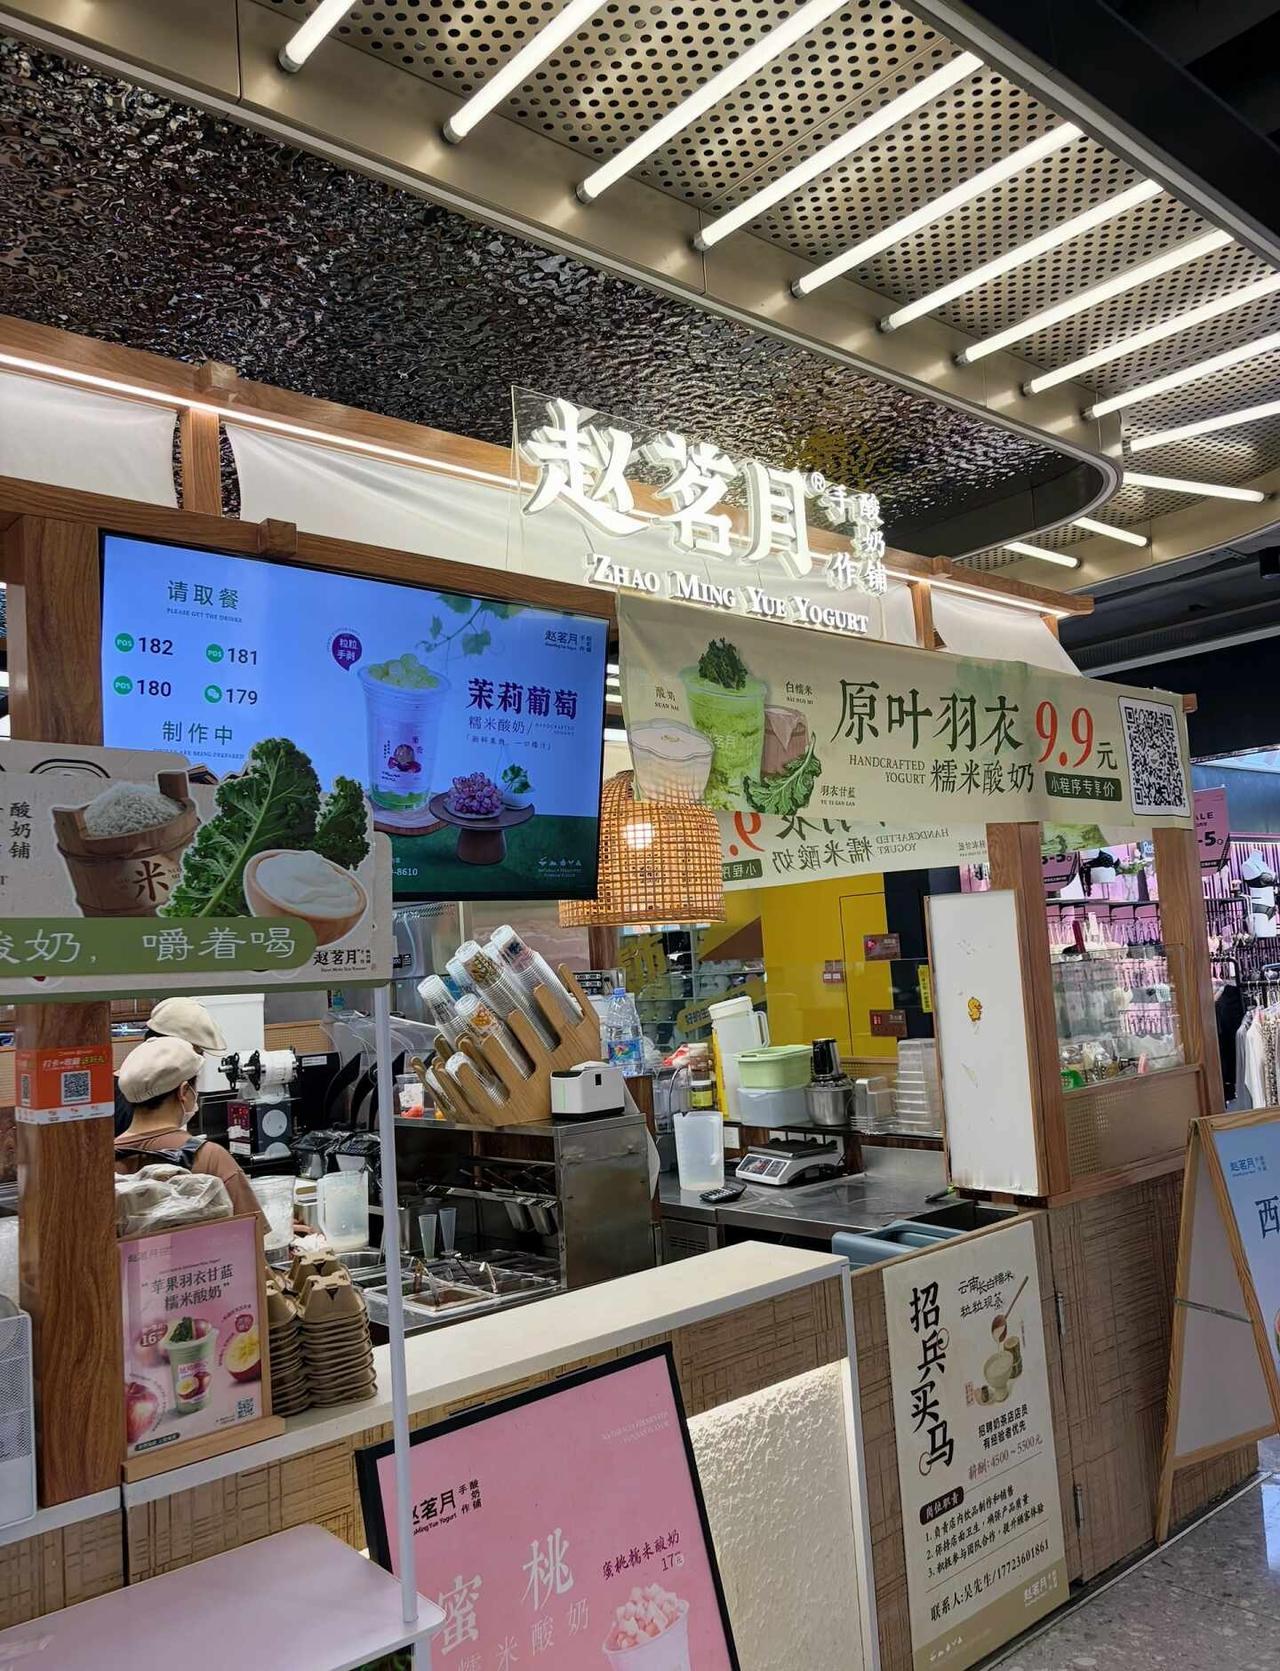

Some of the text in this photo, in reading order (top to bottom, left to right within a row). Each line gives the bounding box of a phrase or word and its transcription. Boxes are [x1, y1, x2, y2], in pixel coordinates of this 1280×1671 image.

[519, 398, 812, 578] 赵茗月
[167, 580, 239, 610] 请取餐
[590, 554, 869, 634] ZHAO MING YUE YOGURT
[116, 637, 174, 655] POS 182
[207, 648, 258, 665] POS 181
[115, 679, 171, 697] POS 180
[226, 688, 258, 705] 179
[466, 677, 578, 720] 茉莉葡萄
[655, 687, 676, 702] 酸奶
[786, 681, 813, 696] 白糯米
[831, 679, 1023, 755] 原叶羽衣
[162, 720, 233, 746] 制作中
[849, 754, 926, 771] HANDCRAFTED
[930, 759, 1035, 794] 糯米酸奶
[820, 785, 856, 798] 羽衣甘蓝
[884, 771, 926, 785] YOGURT
[1050, 775, 1116, 798] 小程序专享价
[8, 801, 33, 860] 酸奶铺
[132, 860, 170, 902] 米
[142, 926, 296, 962] 嚼着喝
[313, 949, 358, 966] 赵茗月
[1254, 1195, 1280, 1239] 西
[909, 1281, 955, 1467] 招兵买马
[978, 1403, 1029, 1439] 招聘奶茶店店员
[983, 1420, 1027, 1451] 有经验者优先
